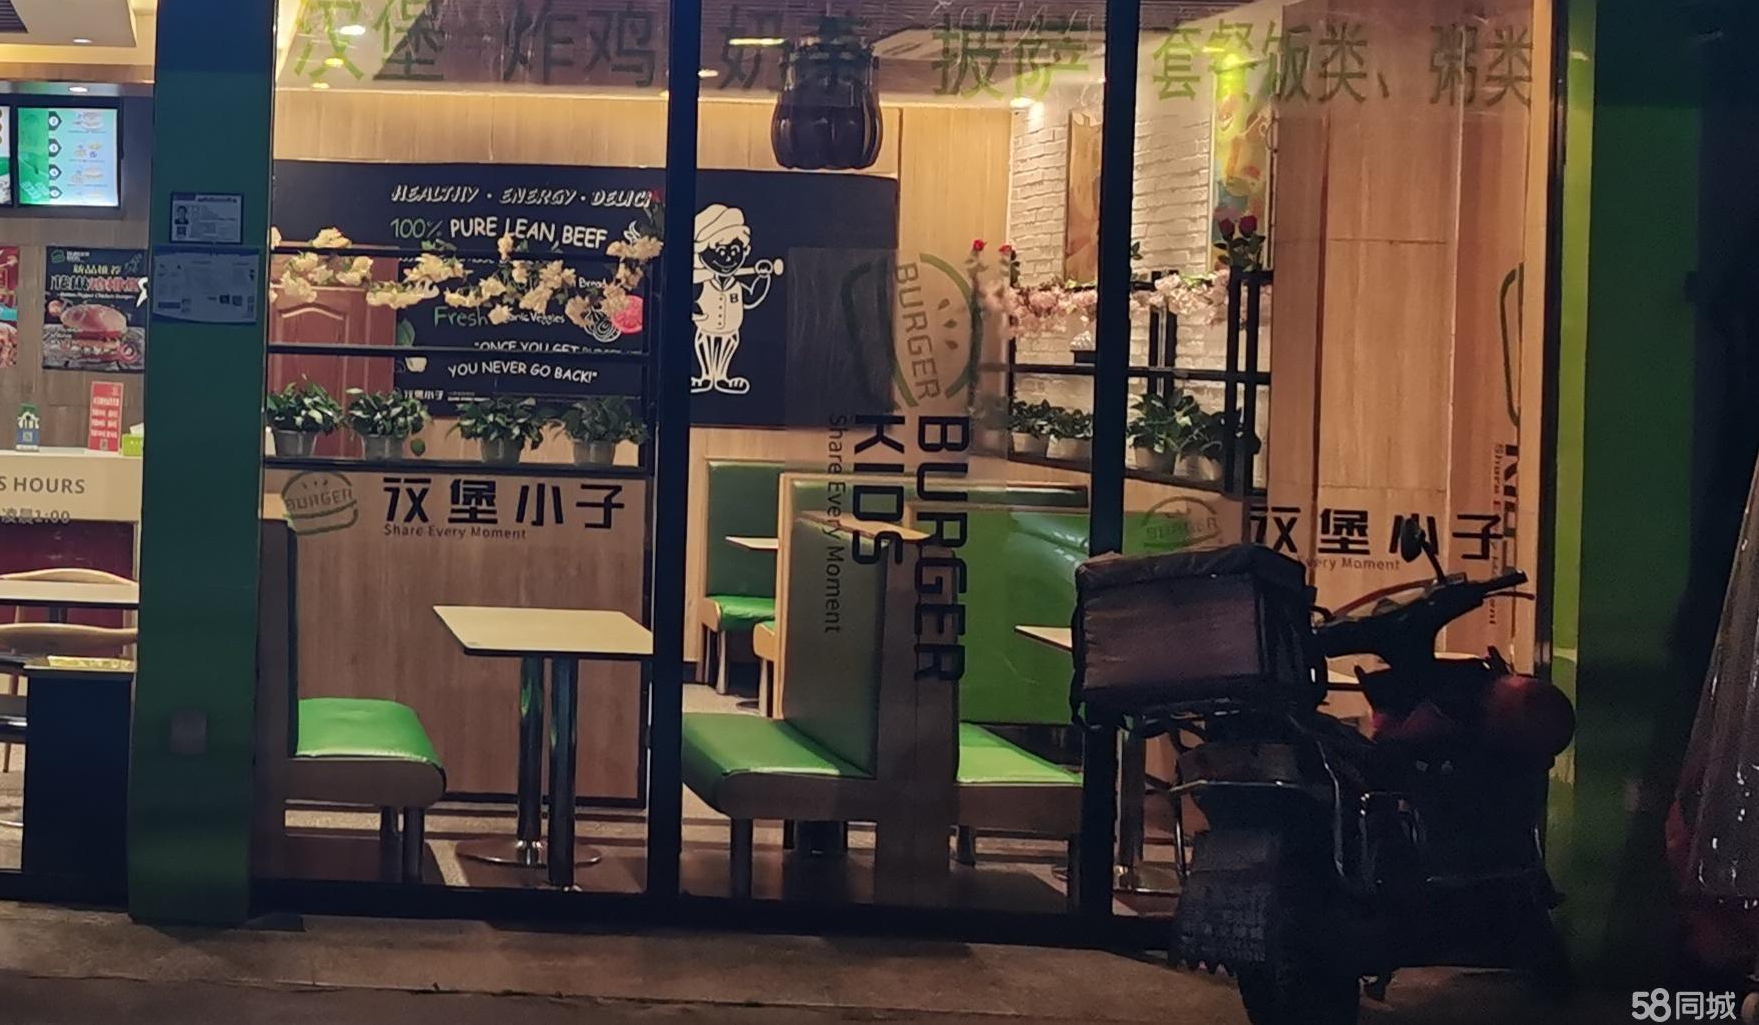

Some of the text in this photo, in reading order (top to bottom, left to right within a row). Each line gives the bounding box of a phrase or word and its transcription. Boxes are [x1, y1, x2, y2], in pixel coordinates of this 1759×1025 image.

[932, 13, 1089, 100] 披萨
[392, 184, 479, 203] HEALTHY
[499, 187, 576, 206] ENERGY
[391, 218, 444, 239] 100%
[450, 217, 498, 239] PURE
[562, 225, 609, 248] BEEF
[434, 305, 489, 326] Fresh
[895, 261, 941, 402] BURGER
[448, 362, 478, 377] YOU
[482, 361, 527, 376] NEVER
[530, 363, 552, 378] GO
[13, 476, 86, 495] HOURS
[852, 415, 905, 564] KIDS
[285, 488, 354, 512] BURGER
[383, 477, 625, 529] 汉堡小子
[383, 523, 527, 540] Share Every Moment
[821, 415, 847, 633] Share Every Moment
[914, 415, 970, 681] BURGER
[1300, 556, 1401, 572] very Moment
